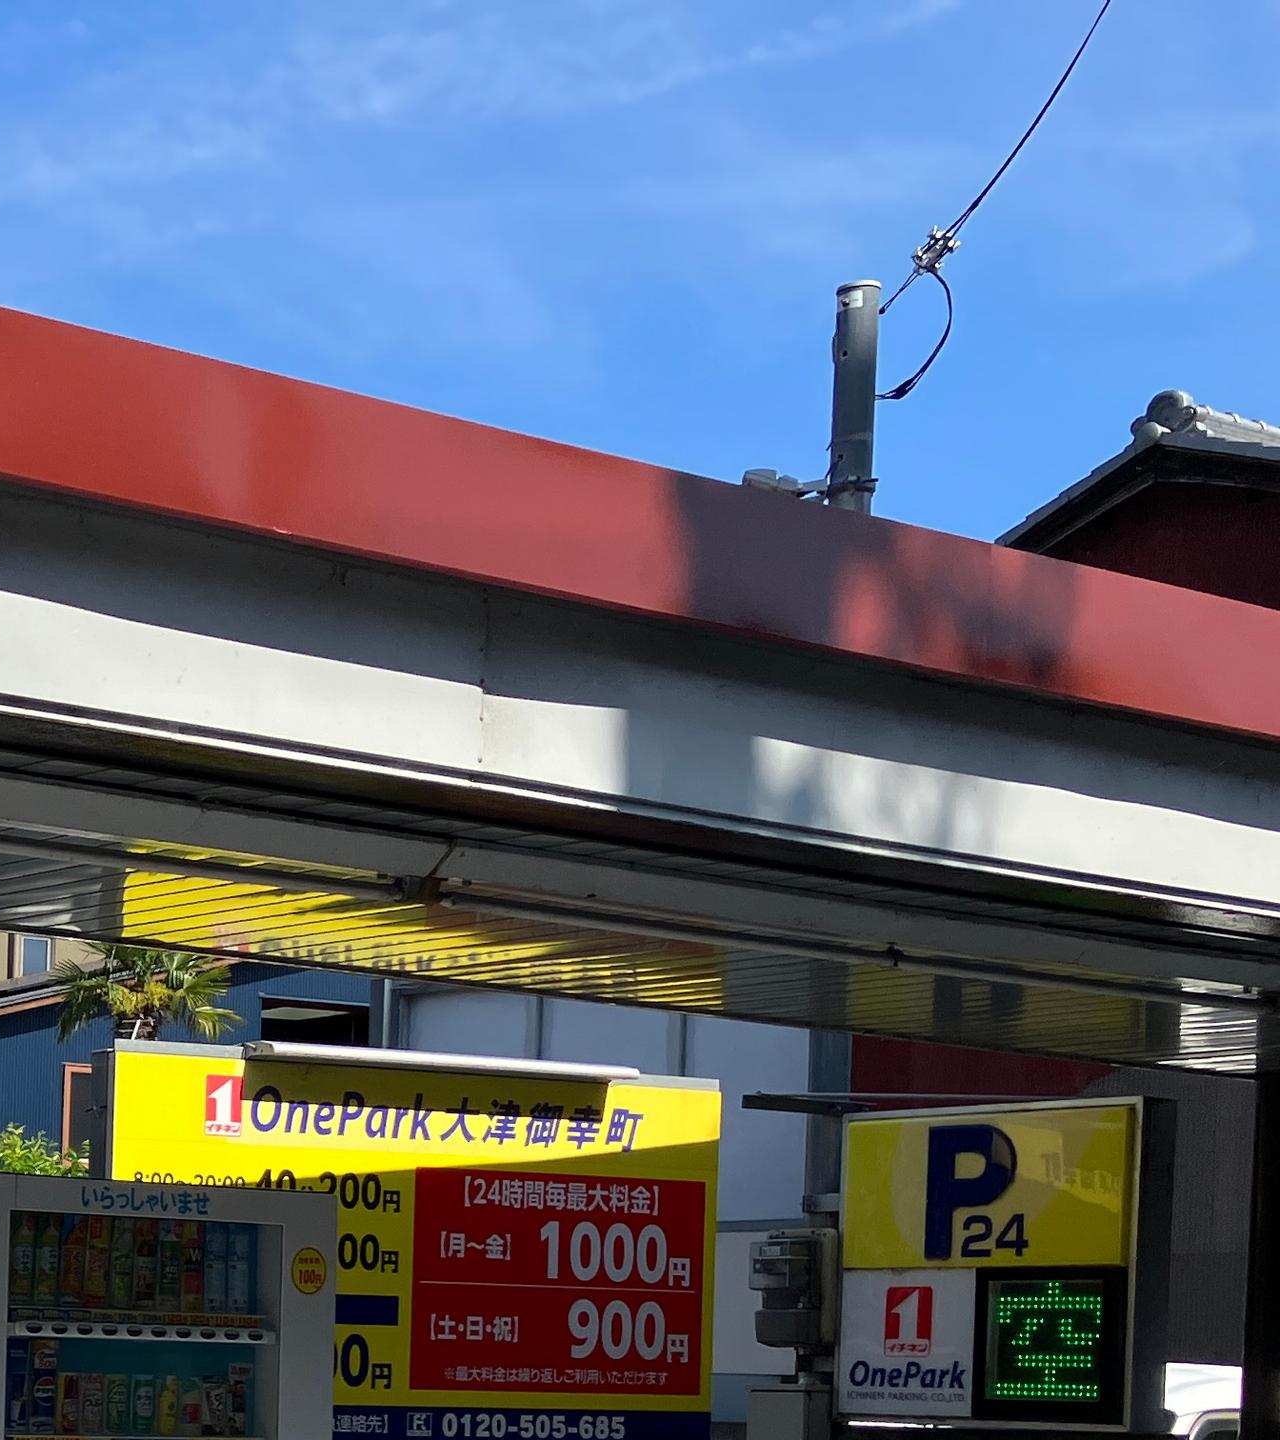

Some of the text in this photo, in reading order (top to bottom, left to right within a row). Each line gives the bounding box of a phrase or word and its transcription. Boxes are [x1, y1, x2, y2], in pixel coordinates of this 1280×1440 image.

[81, 1186, 210, 1215] いらっしゃいませ
[464, 1175, 659, 1216] 【24時間毎最大料金】
[924, 1124, 1017, 1260] P
[540, 1220, 690, 1287] 1000円
[961, 1214, 1029, 1258] 24
[567, 1298, 689, 1363] 900円
[995, 1282, 1101, 1397] 空
[333, 1334, 392, 1389] 0円
[849, 1360, 965, 1388] OnePark
[332, 1412, 626, 1440] 連絡先】 0120-505-685
